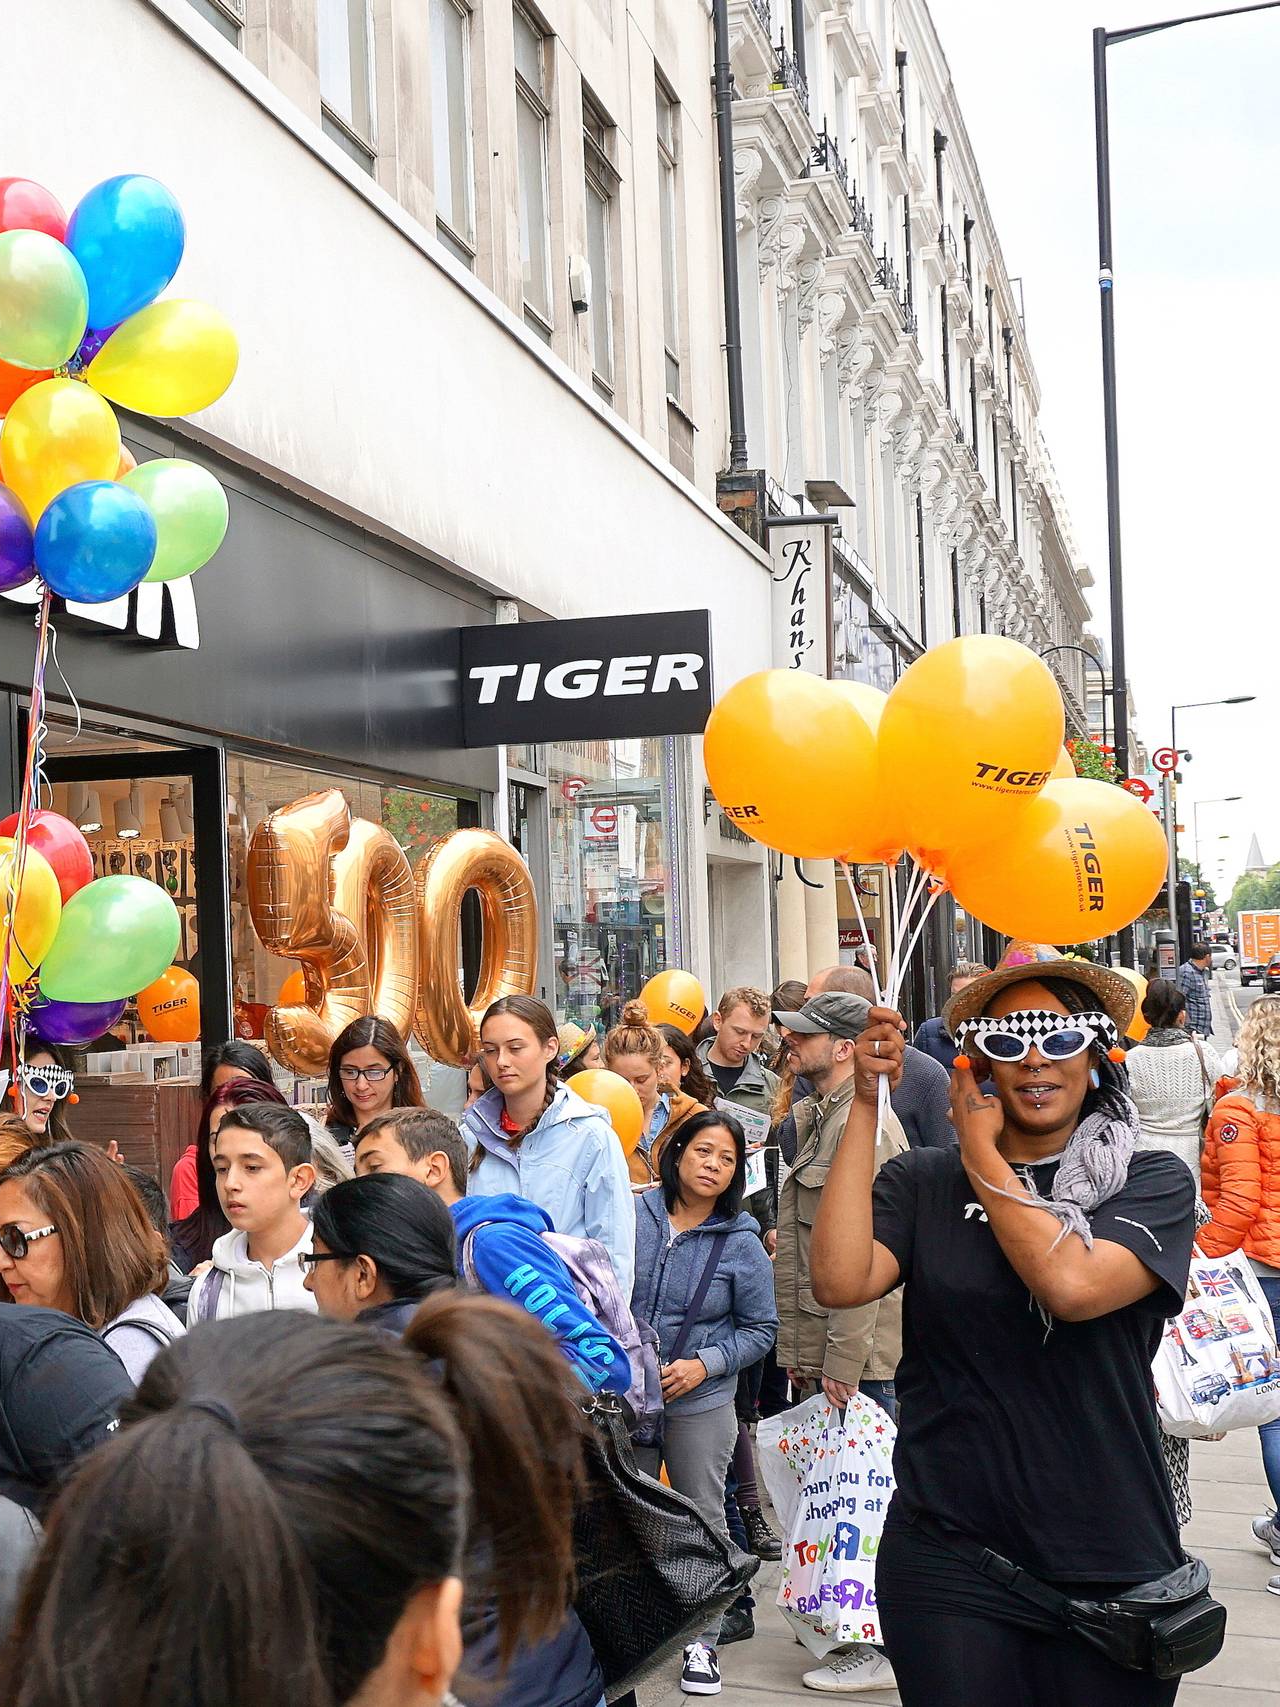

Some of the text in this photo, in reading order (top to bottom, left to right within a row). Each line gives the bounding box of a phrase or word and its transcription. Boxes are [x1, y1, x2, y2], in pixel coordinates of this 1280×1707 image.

[773, 540, 814, 669] Khan's
[469, 653, 704, 704] TIGER
[976, 762, 1051, 786] TIGER
[723, 805, 760, 818] GER
[1074, 822, 1104, 912] TIGER
[839, 932, 863, 945] Khan's
[151, 997, 188, 1014] TIGER
[669, 1001, 697, 1021] TIGER
[867, 1468, 893, 1488] for
[864, 1498, 883, 1513] at
